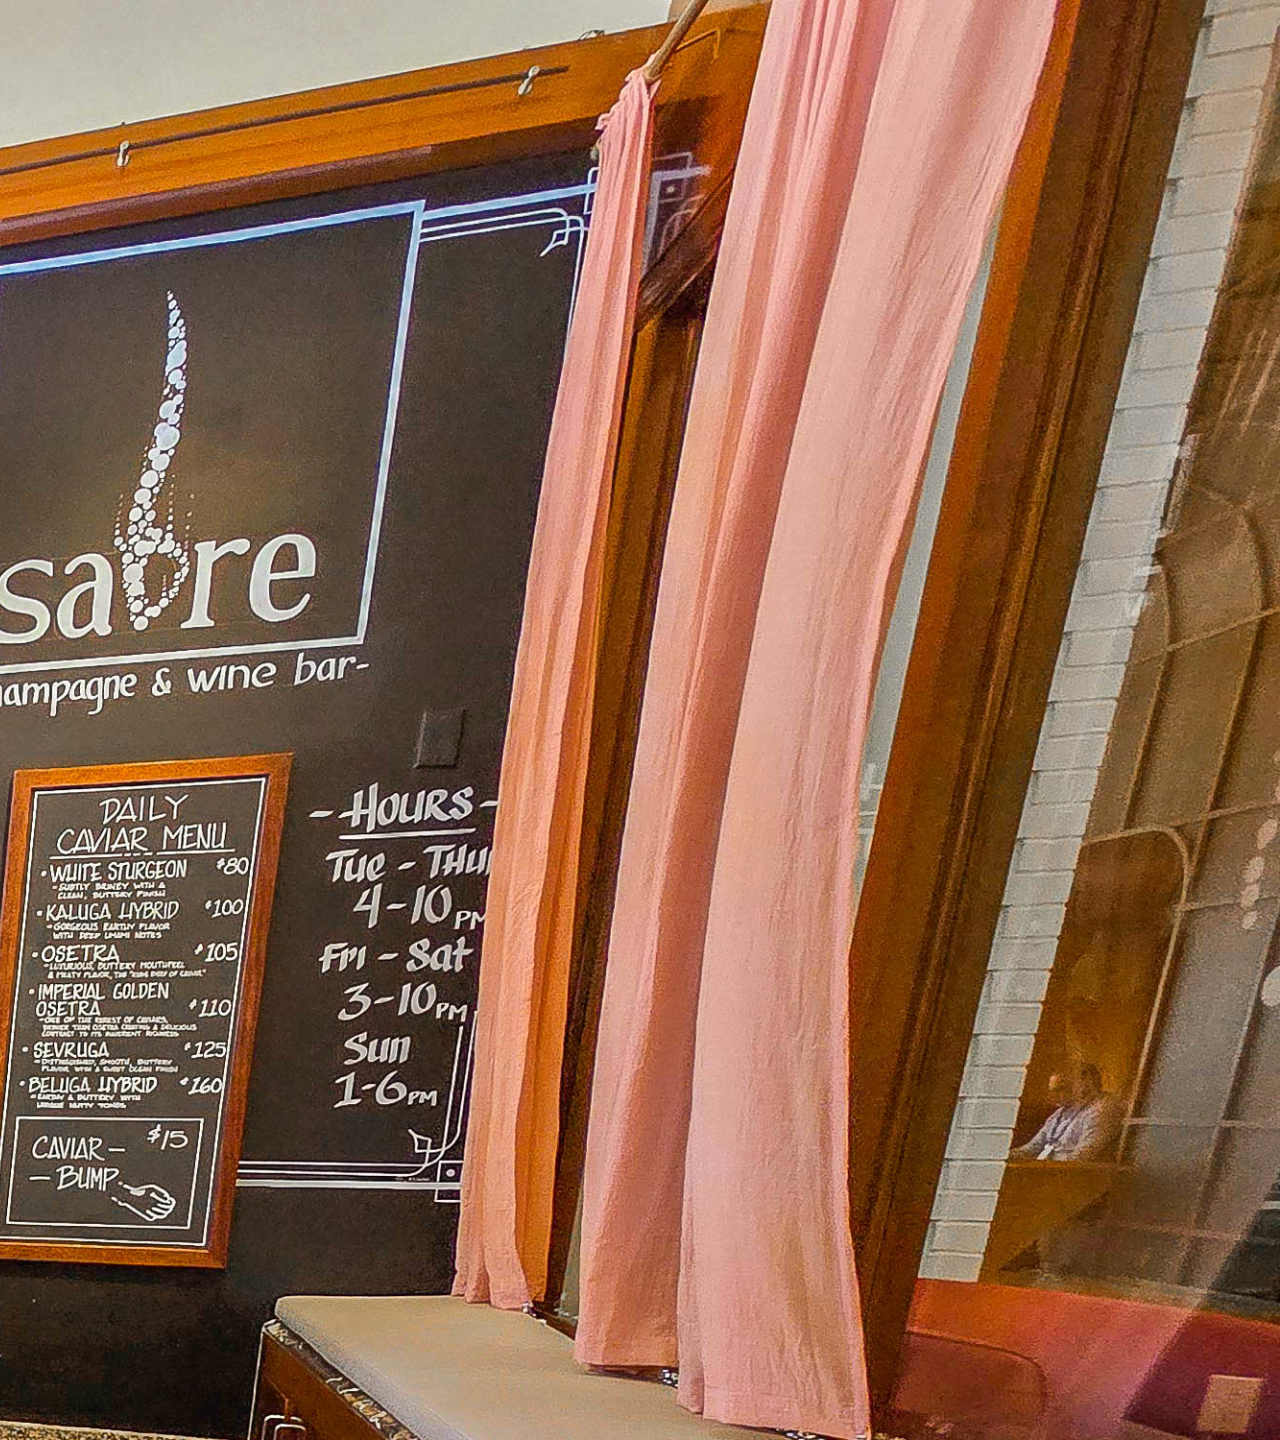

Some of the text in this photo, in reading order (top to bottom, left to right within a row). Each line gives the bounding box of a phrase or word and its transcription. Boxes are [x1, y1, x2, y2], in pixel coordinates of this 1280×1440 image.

[150, 667, 173, 697] &
[186, 662, 277, 694] wine
[99, 793, 190, 825] DAILY
[56, 822, 228, 853] CAVIAR MENU
[49, 859, 188, 882] WHITE STURGEON
[216, 857, 250, 876] $80
[325, 848, 387, 883] Tue
[45, 900, 180, 921] KALUGA HYBRID
[204, 899, 244, 918] $100
[41, 944, 120, 964] OSETRA
[194, 942, 238, 962] $105
[405, 935, 475, 973] Sat
[38, 981, 170, 1001] IMPERIAL GOLDEN
[35, 1000, 101, 1017] OSETRA
[189, 998, 232, 1018] $110
[33, 1041, 110, 1059] SEVRUGA
[184, 1041, 227, 1059] $125
[343, 1031, 412, 1066] Sun
[28, 1076, 158, 1094] BELUGA HYBRID
[179, 1076, 223, 1095] $160
[147, 1123, 189, 1150] $15
[32, 1135, 105, 1162] CAVIAR
[55, 1164, 120, 1192] BUMP
